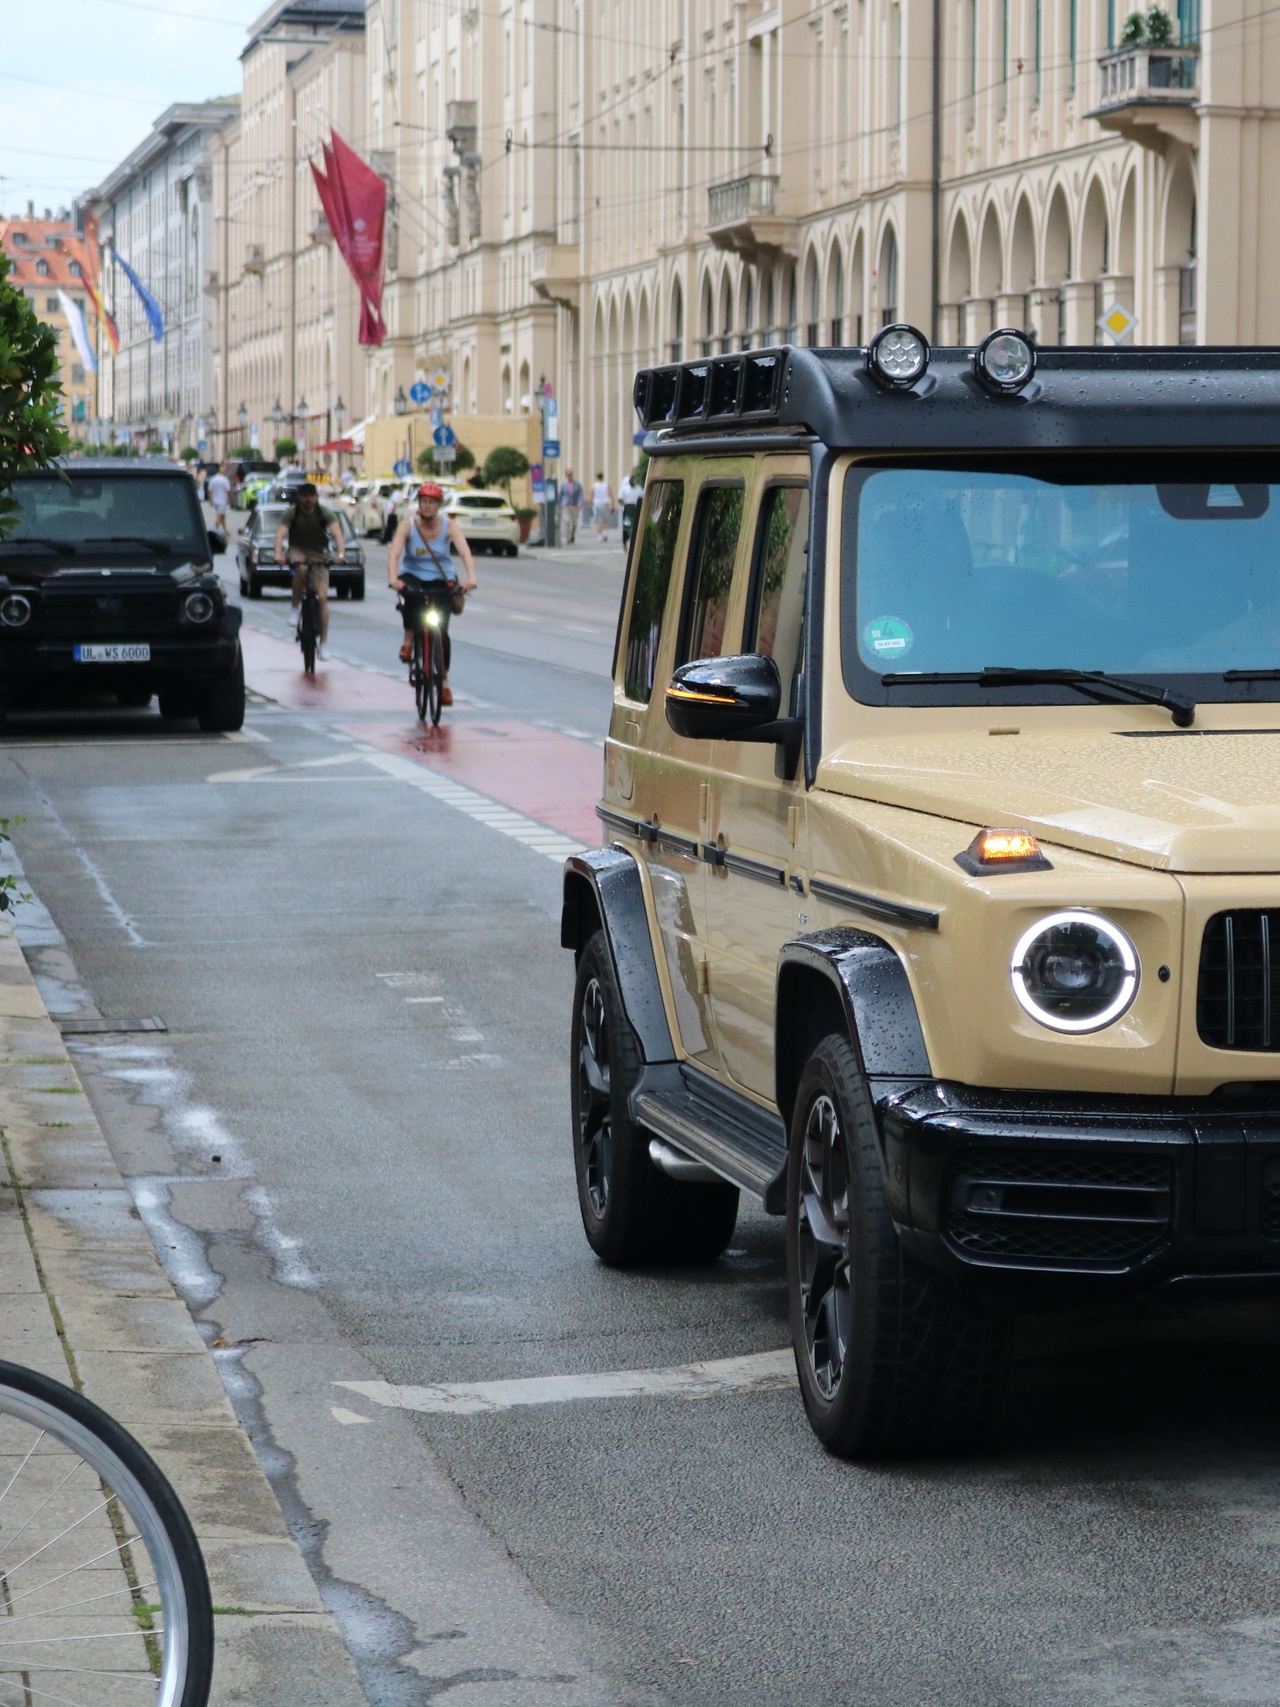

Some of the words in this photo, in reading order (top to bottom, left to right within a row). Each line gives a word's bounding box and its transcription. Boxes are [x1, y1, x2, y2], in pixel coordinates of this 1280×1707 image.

[82, 647, 96, 660] UL
[104, 647, 119, 660] WS
[121, 647, 149, 660] 6000
